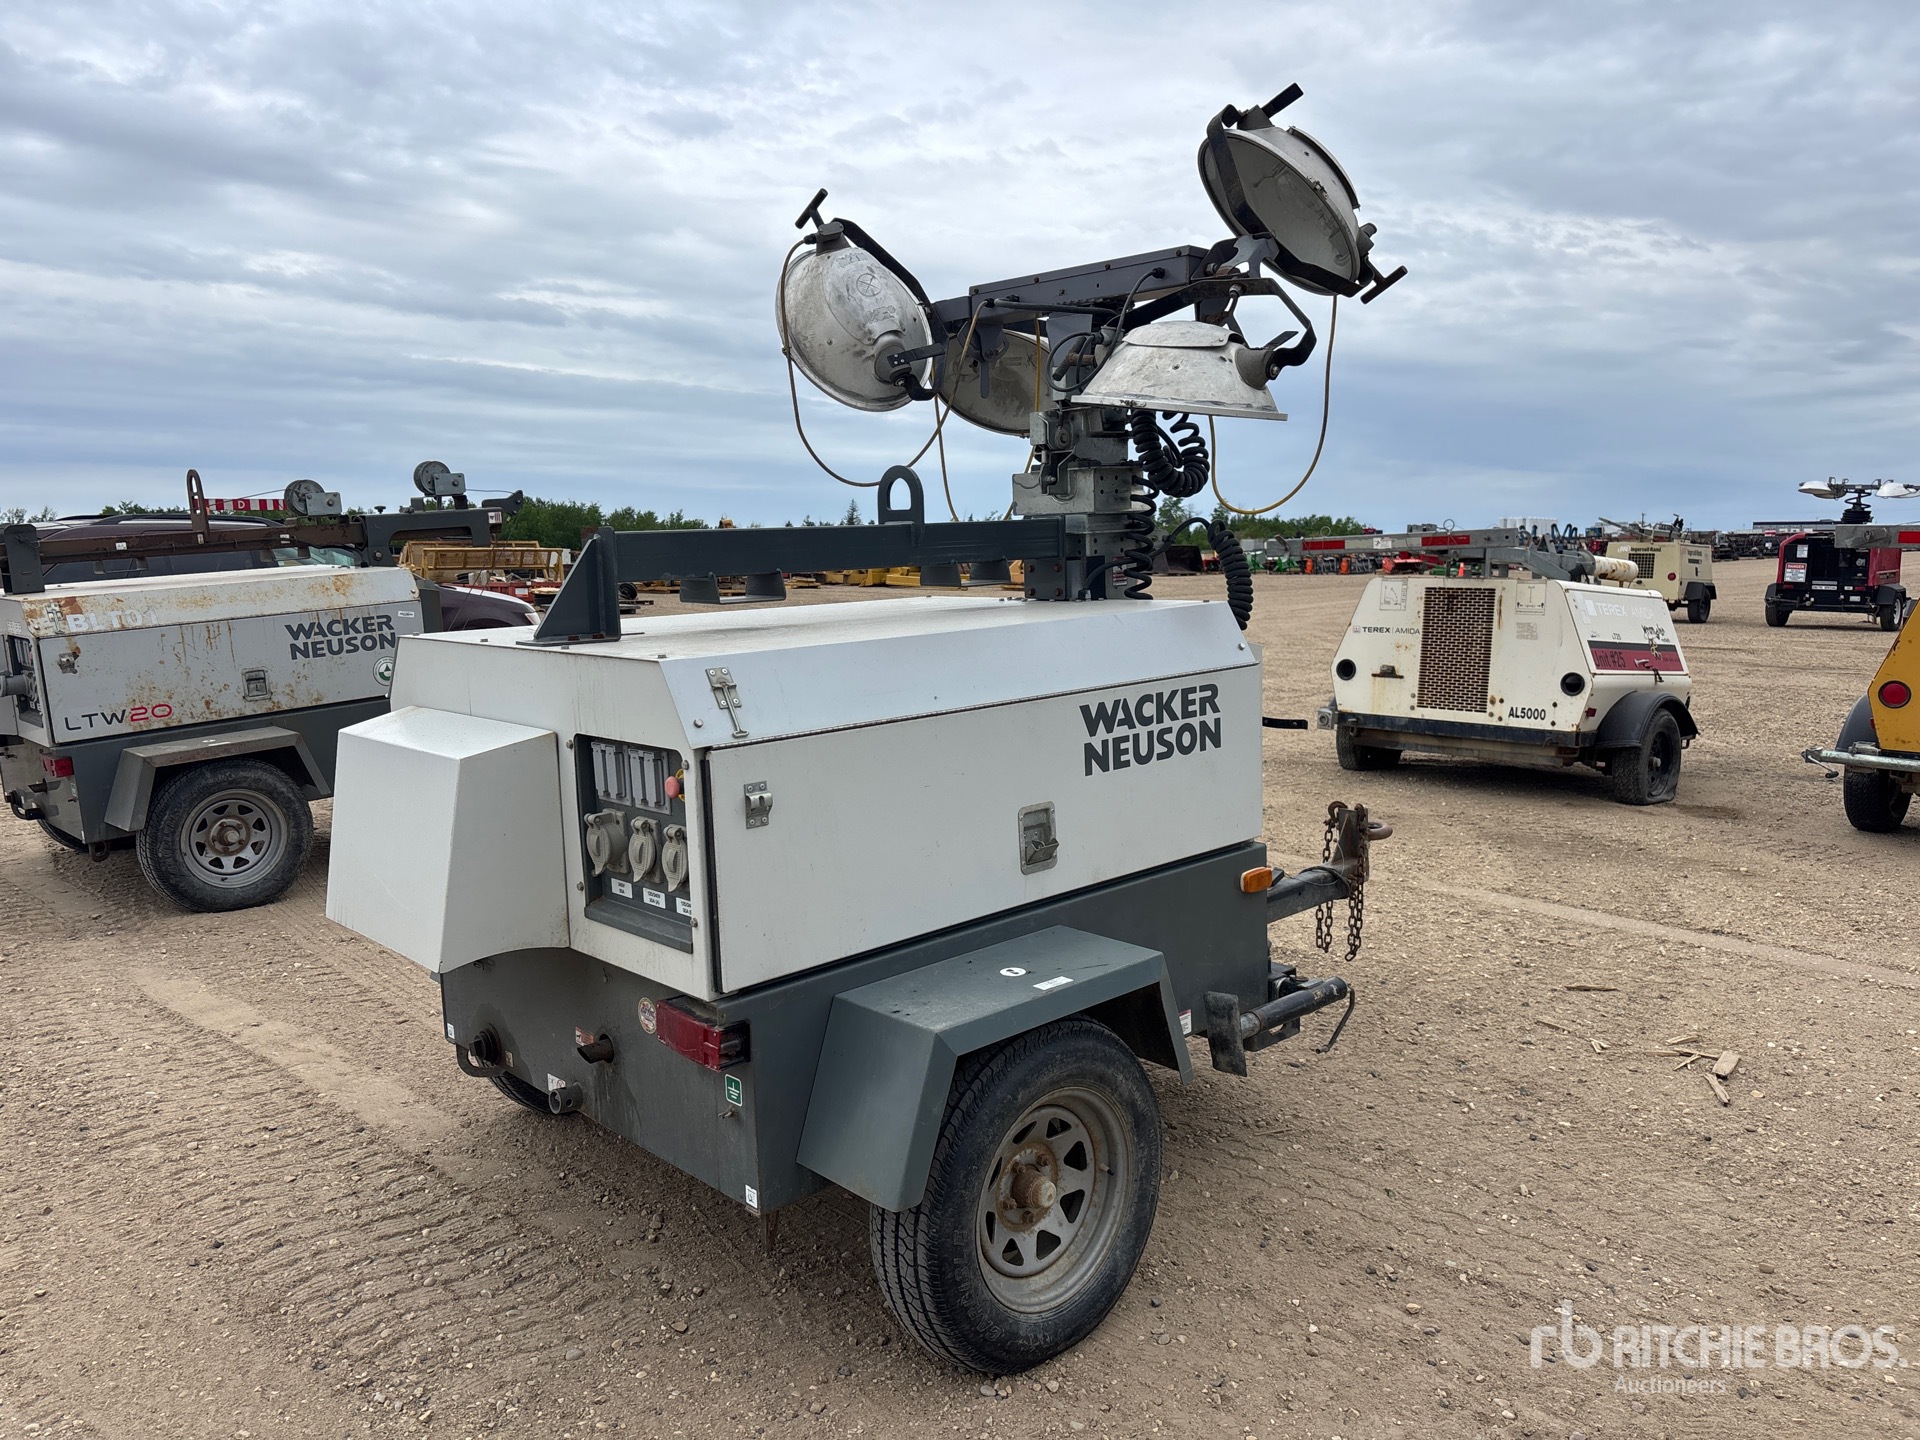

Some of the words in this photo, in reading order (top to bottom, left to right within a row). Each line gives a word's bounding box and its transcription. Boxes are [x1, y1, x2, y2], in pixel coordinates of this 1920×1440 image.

[1597, 602, 1628, 617] TEREX
[284, 614, 395, 641] WACKER
[1362, 626, 1391, 634] TEREX
[1394, 626, 1421, 635] AMIDA
[289, 632, 396, 660] NEUSON
[1591, 649, 1612, 668] Unit
[1610, 650, 1626, 668] #25
[64, 703, 173, 731] LTW20
[1079, 683, 1221, 738] WACKER
[1508, 706, 1546, 721] AL5000
[1083, 717, 1222, 777] NEUSON
[953, 1230, 1005, 1341] CARLISLE
